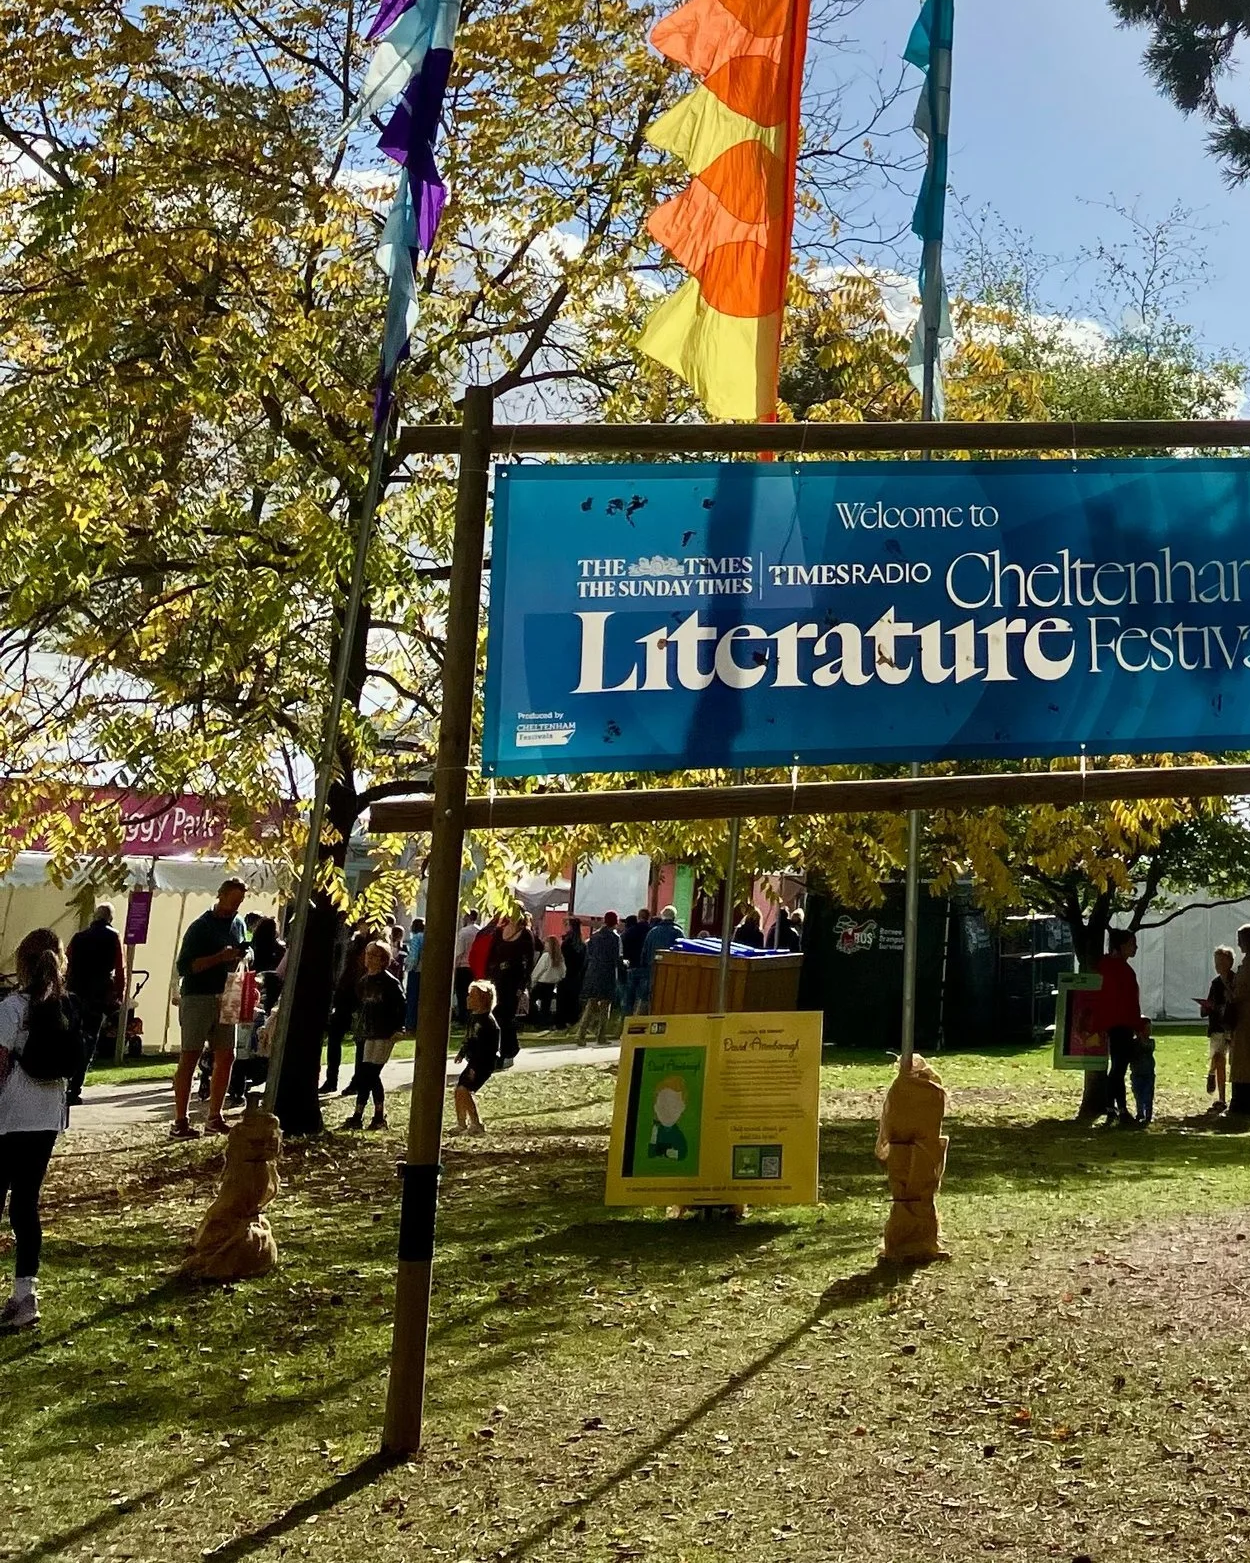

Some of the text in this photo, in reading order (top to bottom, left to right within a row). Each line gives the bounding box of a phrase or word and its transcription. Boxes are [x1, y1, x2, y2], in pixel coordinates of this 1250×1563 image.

[835, 501, 999, 530] Welcome to
[577, 556, 753, 578] THE TIMES
[577, 577, 753, 598] THE SUNDAY TIMES
[569, 605, 1076, 694] Literature
[517, 711, 564, 720] Produced by
[516, 722, 576, 731] CHELTENHAM
[519, 733, 553, 741] Festivals
[172, 807, 214, 837] Park
